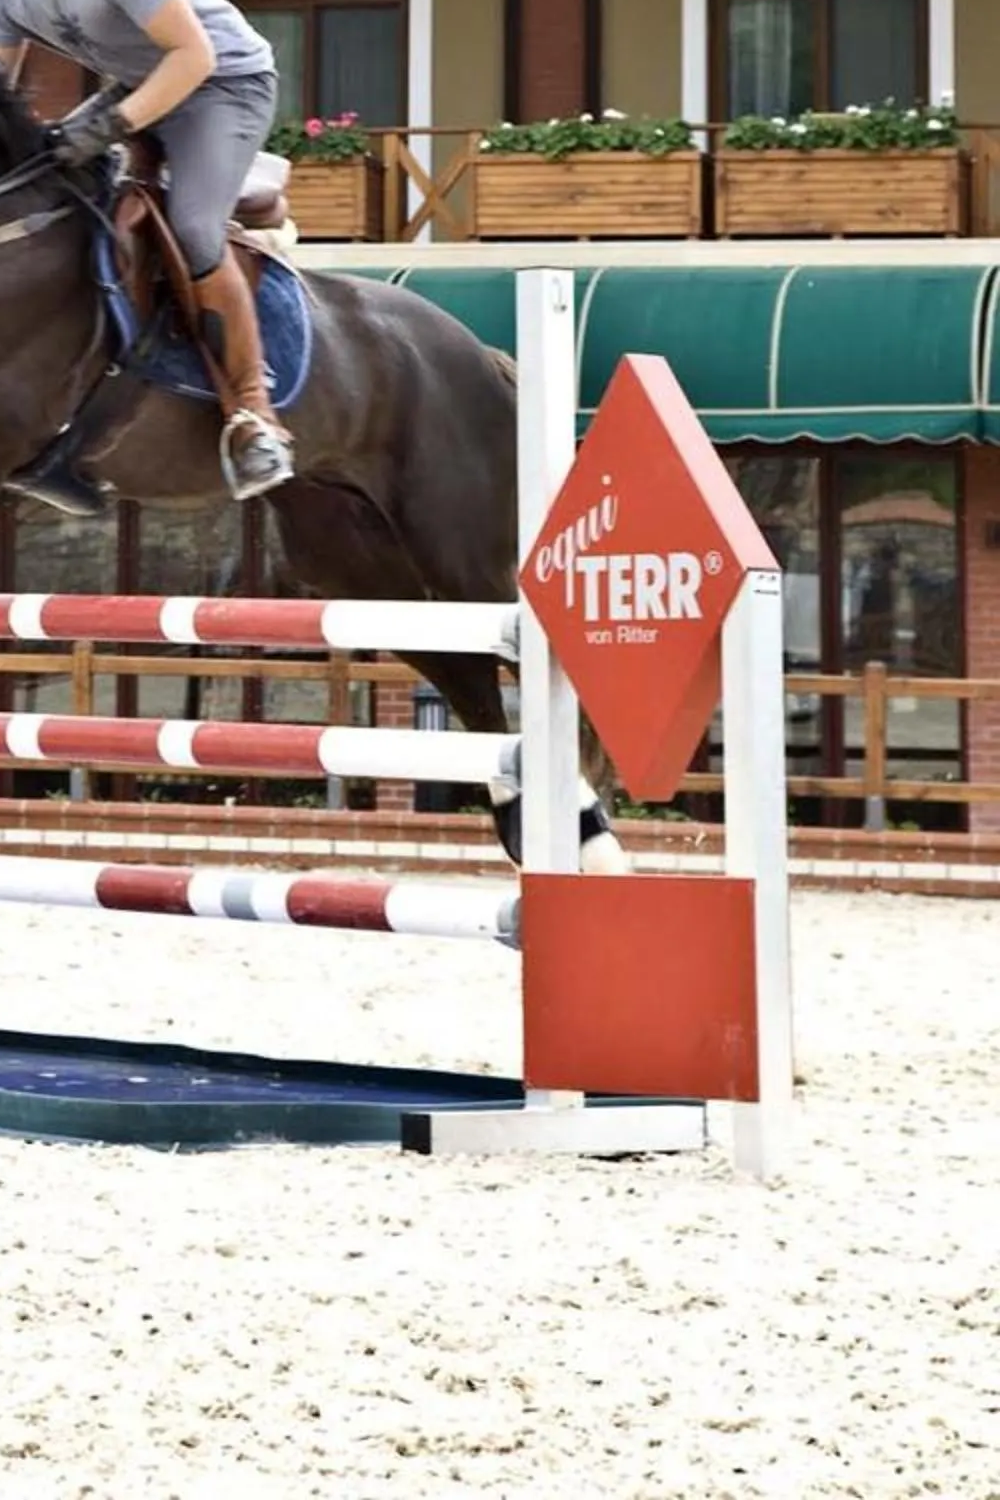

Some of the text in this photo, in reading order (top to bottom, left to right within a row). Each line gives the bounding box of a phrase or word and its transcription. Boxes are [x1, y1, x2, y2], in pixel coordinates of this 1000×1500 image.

[534, 474, 619, 609] equi
[584, 625, 659, 645] von Ritter
